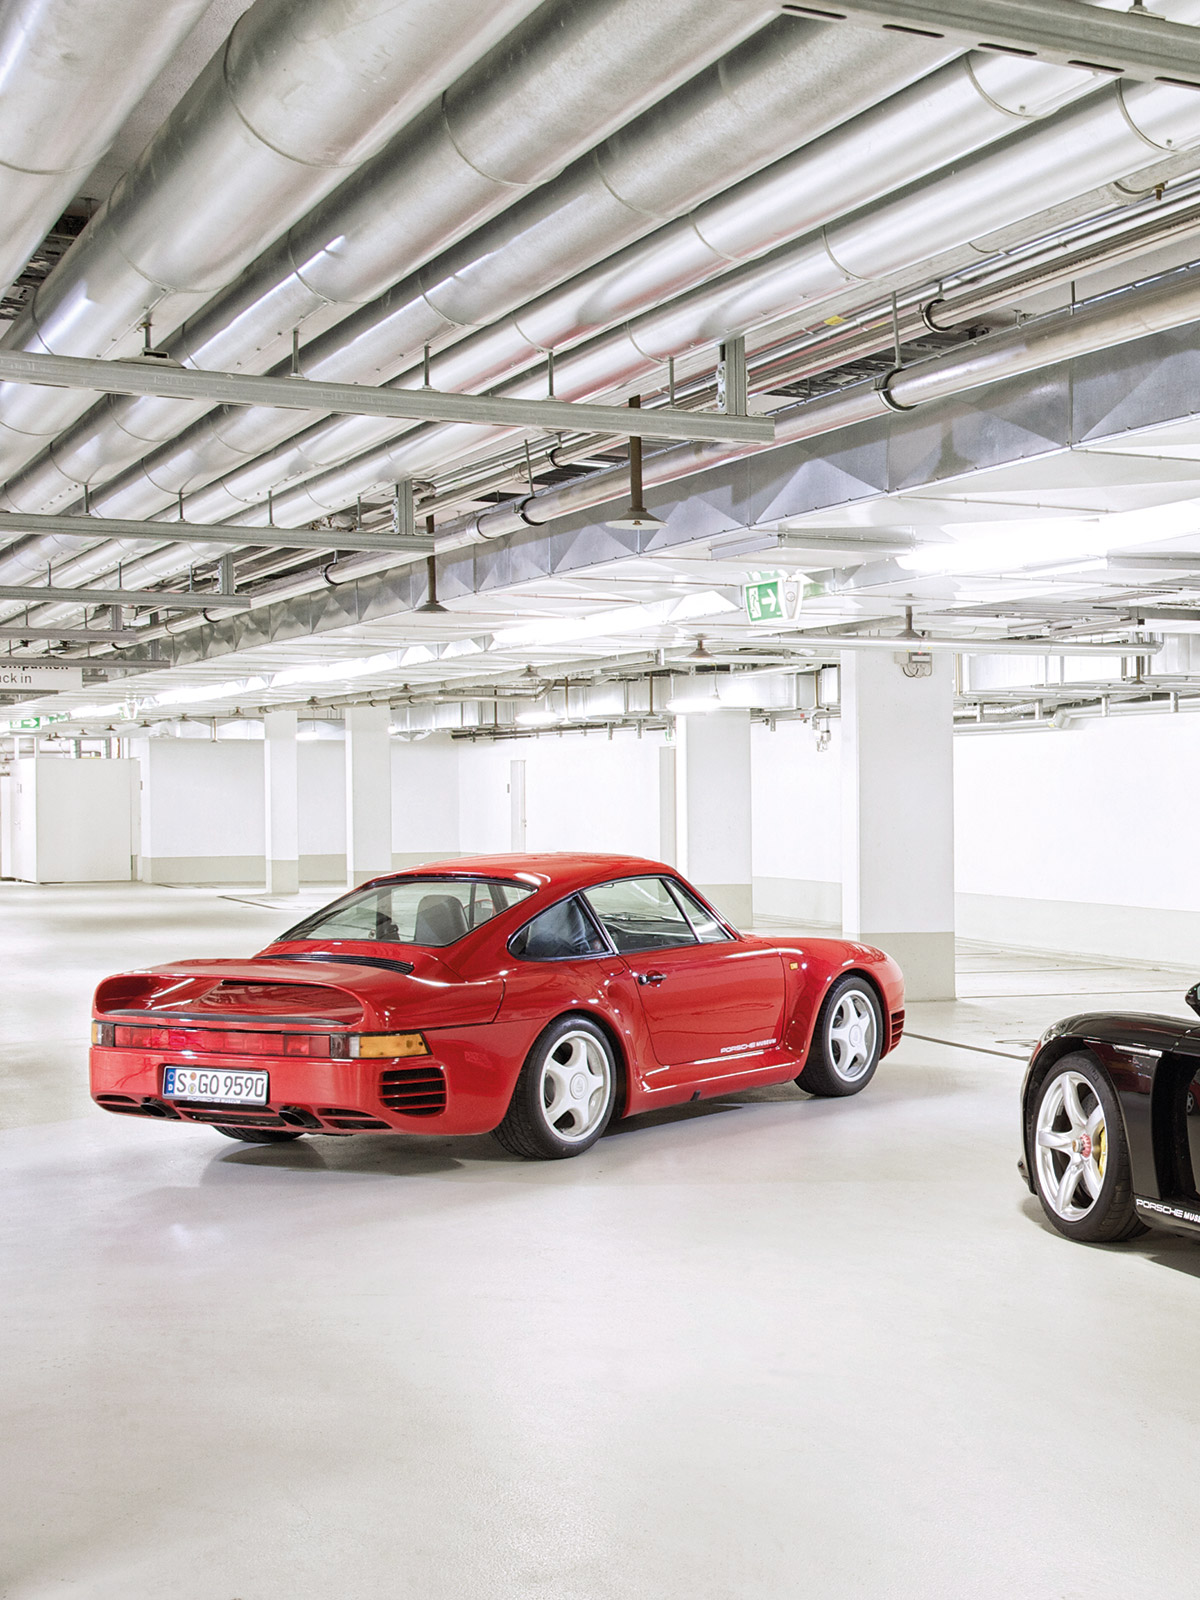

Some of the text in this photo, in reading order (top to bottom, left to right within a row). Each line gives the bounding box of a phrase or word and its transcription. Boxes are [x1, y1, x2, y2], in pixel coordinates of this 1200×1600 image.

[0, 673, 32, 683] ck in
[176, 1073, 187, 1093] S
[198, 1074, 219, 1095] GO
[223, 1075, 264, 1098] 9590
[1136, 1198, 1183, 1218] PORSCHE
